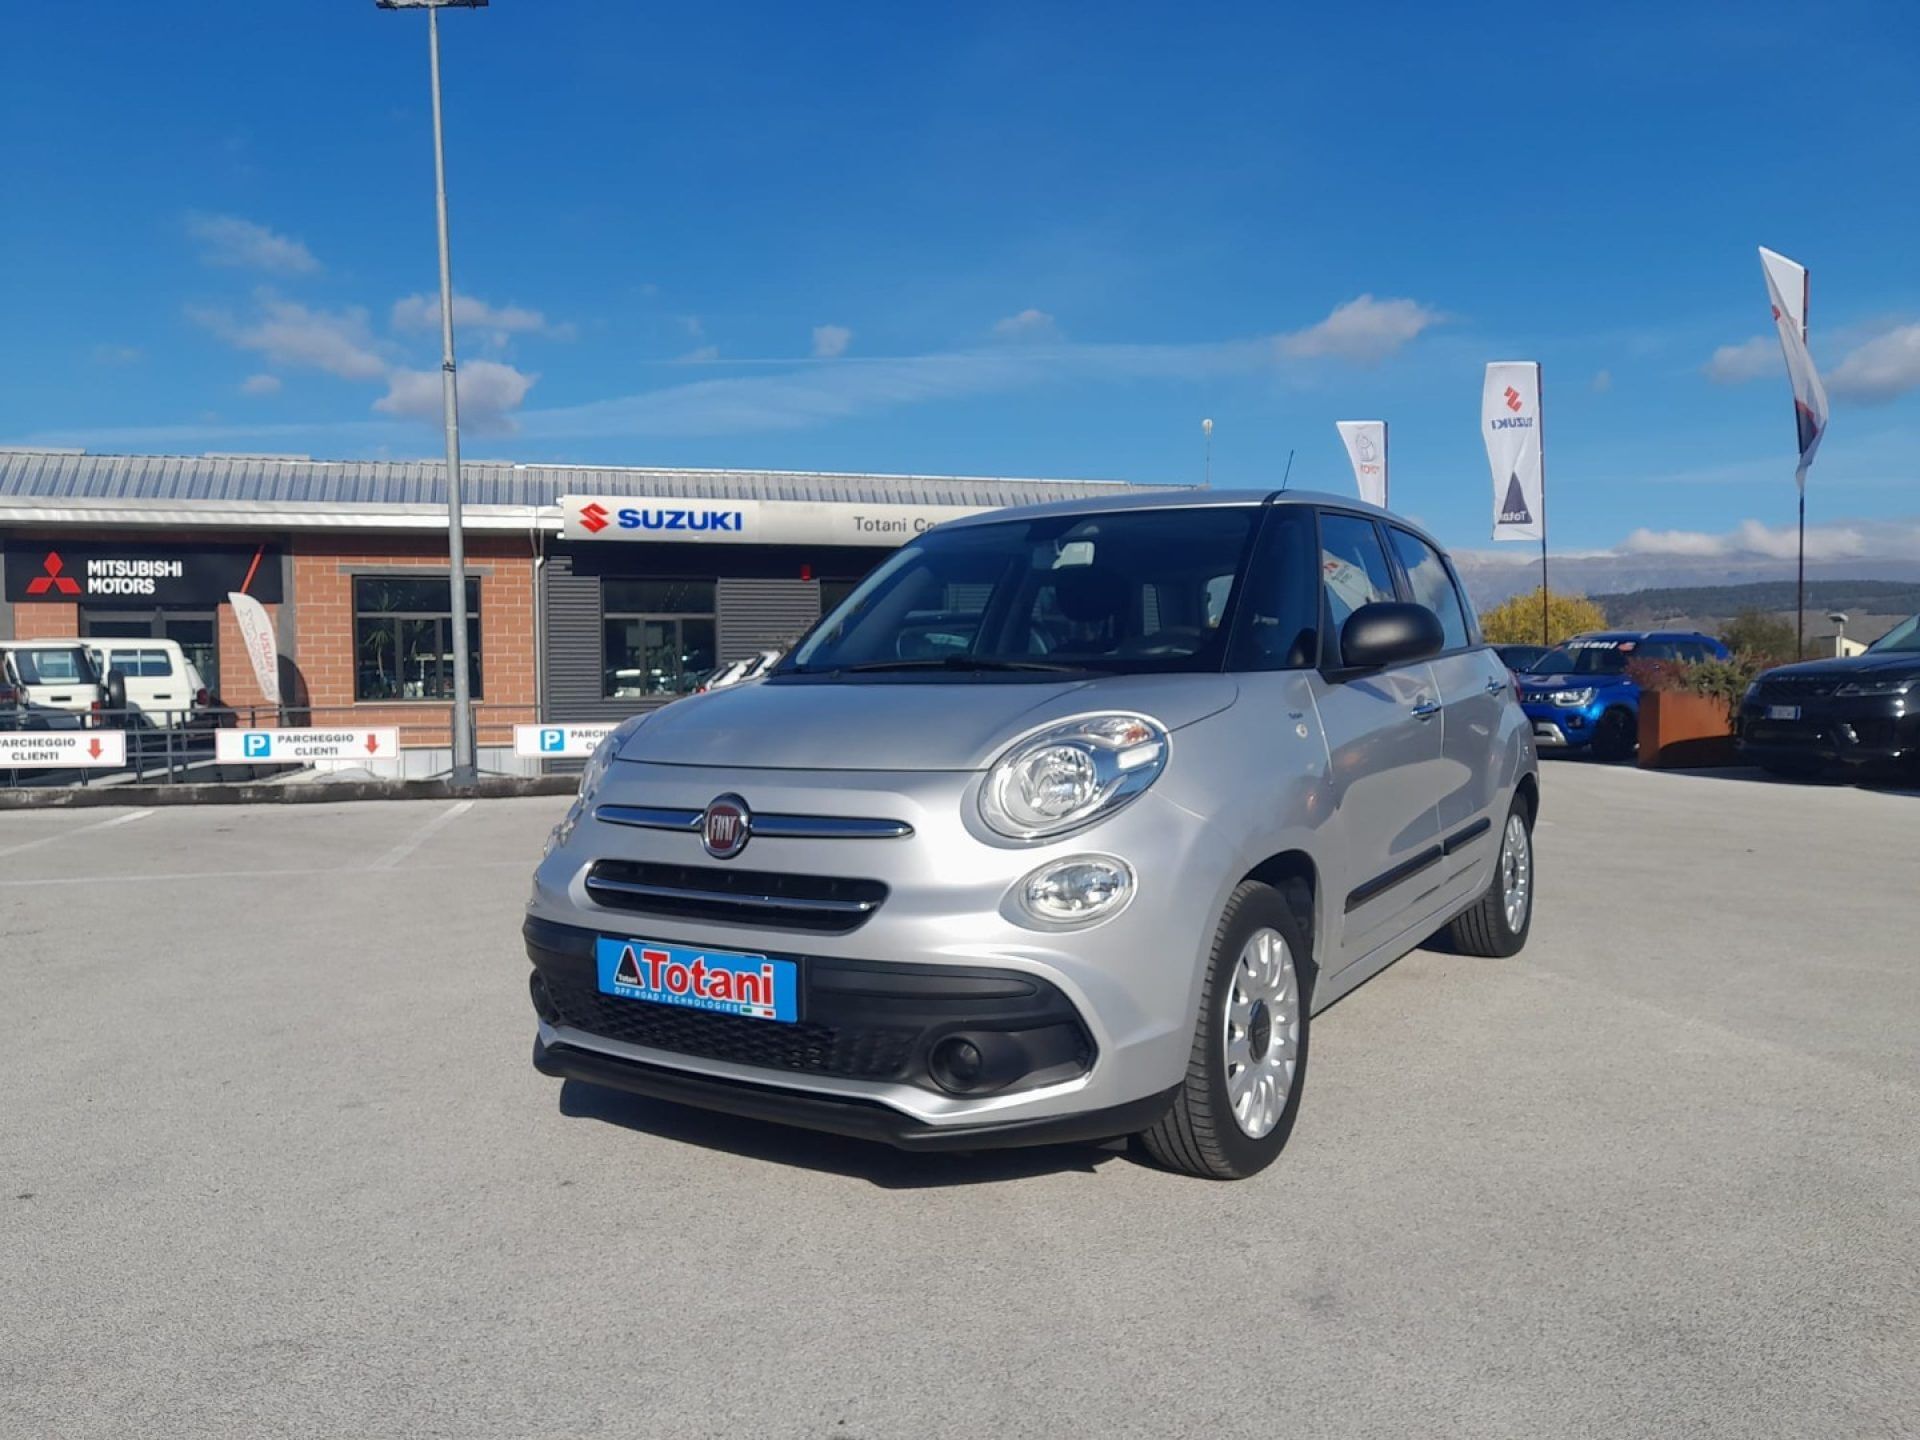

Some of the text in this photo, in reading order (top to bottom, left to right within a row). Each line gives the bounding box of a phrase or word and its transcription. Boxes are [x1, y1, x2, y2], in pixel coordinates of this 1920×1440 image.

[617, 508, 742, 531] SUZUKI
[853, 515, 906, 533] Totani
[87, 559, 183, 578] MITSUBISHI
[87, 577, 156, 595] MOTORS
[0, 737, 77, 749] ARCHEGGIO
[248, 735, 266, 757] P
[277, 733, 355, 744] PARCHEGGIO
[543, 730, 561, 751] P
[11, 751, 60, 761] CLIENTI
[294, 746, 339, 756] CLIENTI
[710, 815, 738, 841] FIAT
[641, 949, 775, 1007] Totani
[614, 985, 741, 1014] OFF ROAD TECHNOLOGIES
